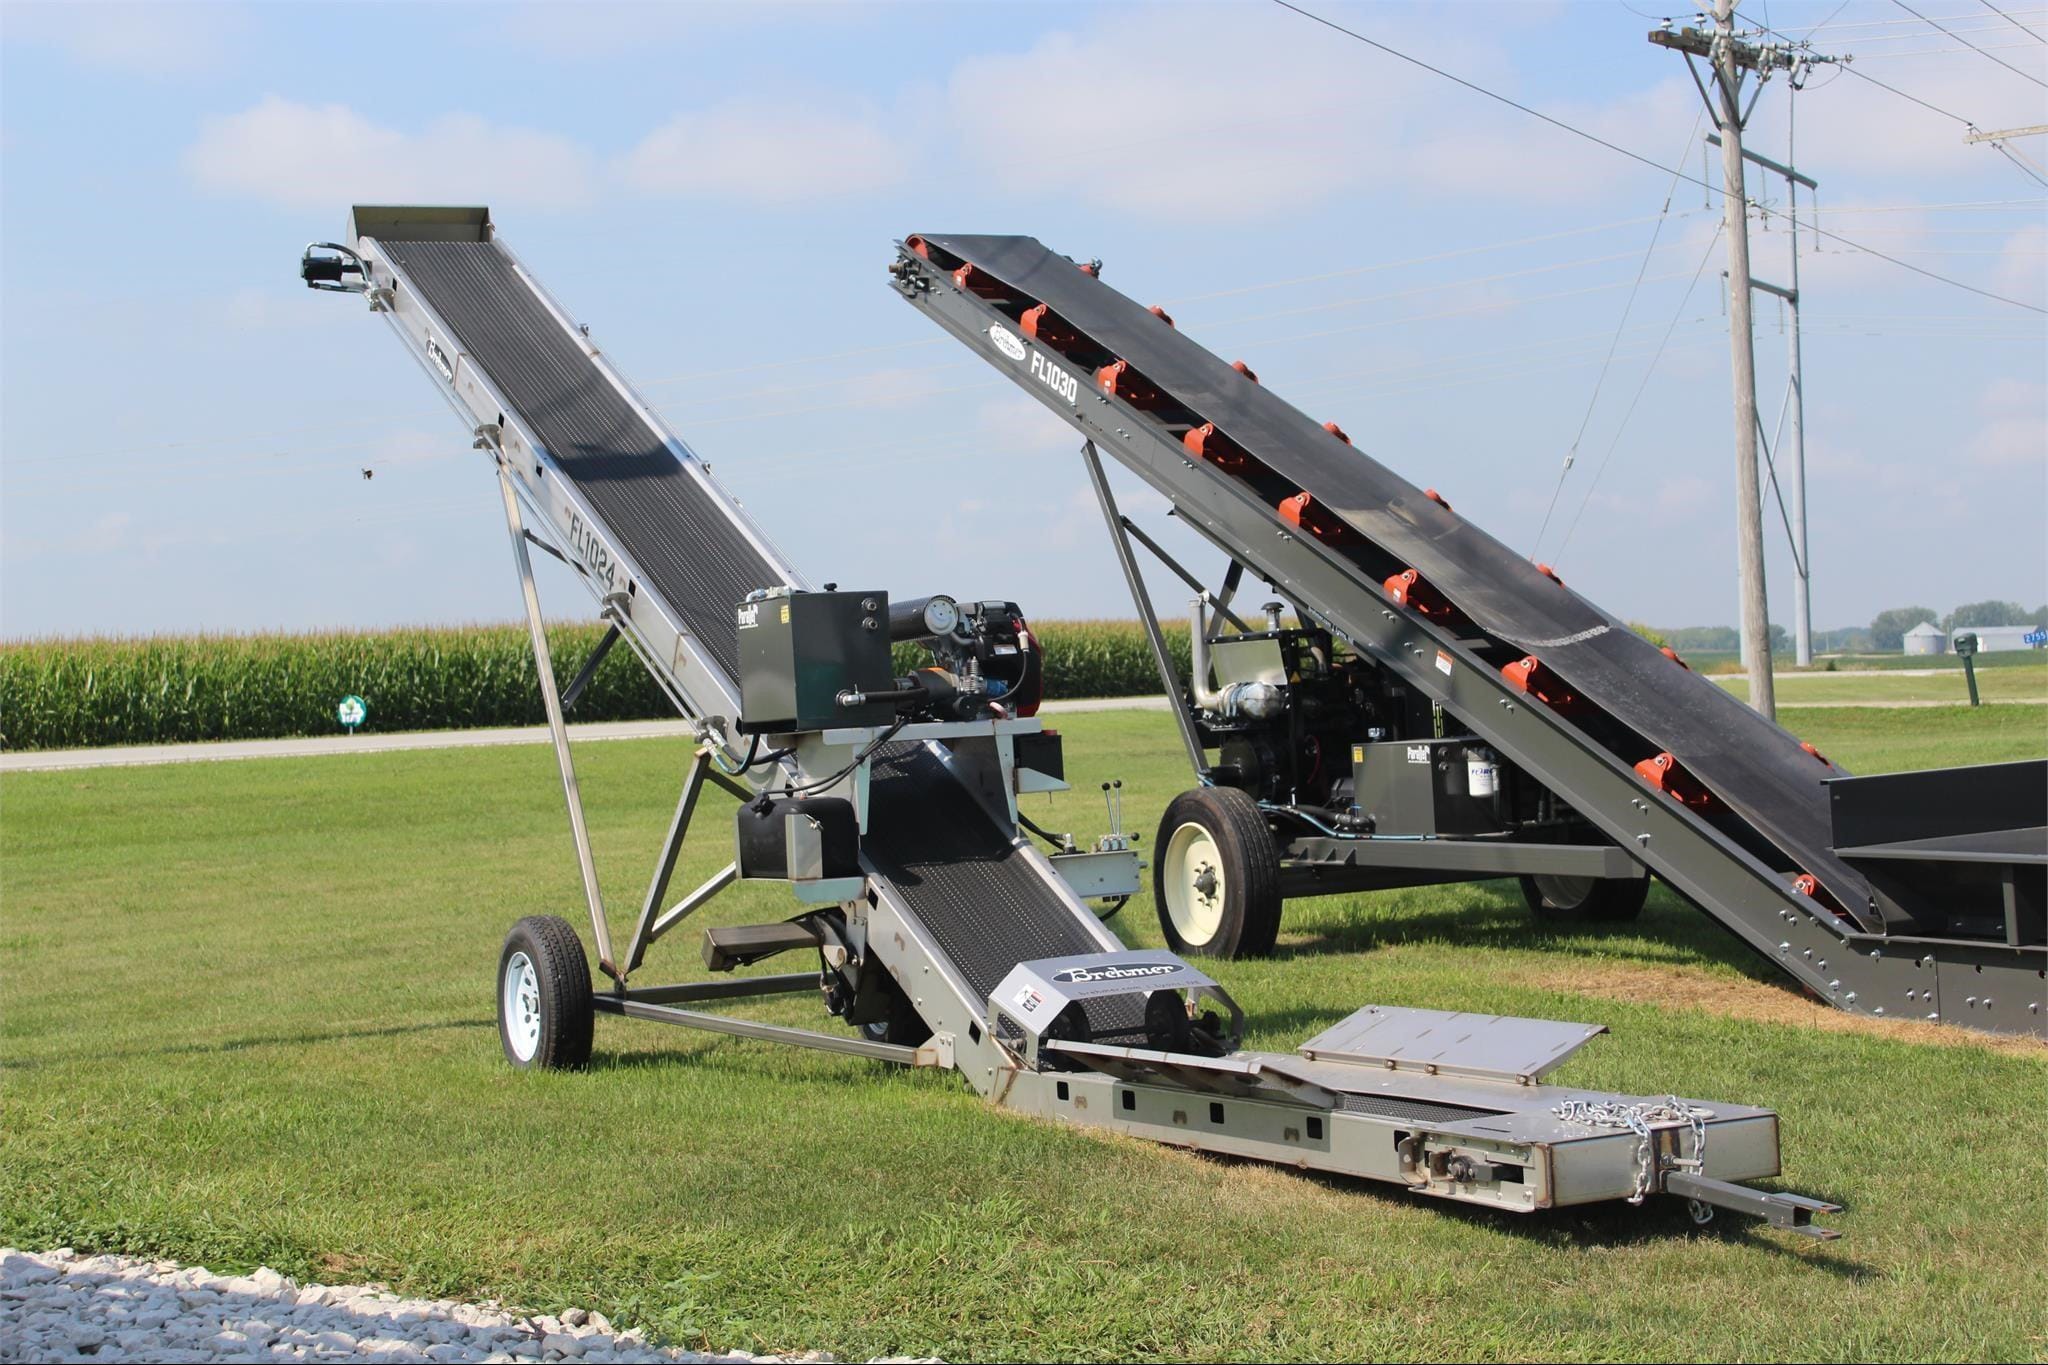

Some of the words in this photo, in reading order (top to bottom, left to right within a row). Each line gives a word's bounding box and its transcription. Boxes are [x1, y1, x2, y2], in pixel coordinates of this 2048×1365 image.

[1031, 350, 1078, 403] FL1030
[570, 512, 615, 591] FL1024
[1056, 965, 1174, 982] Brehmer
